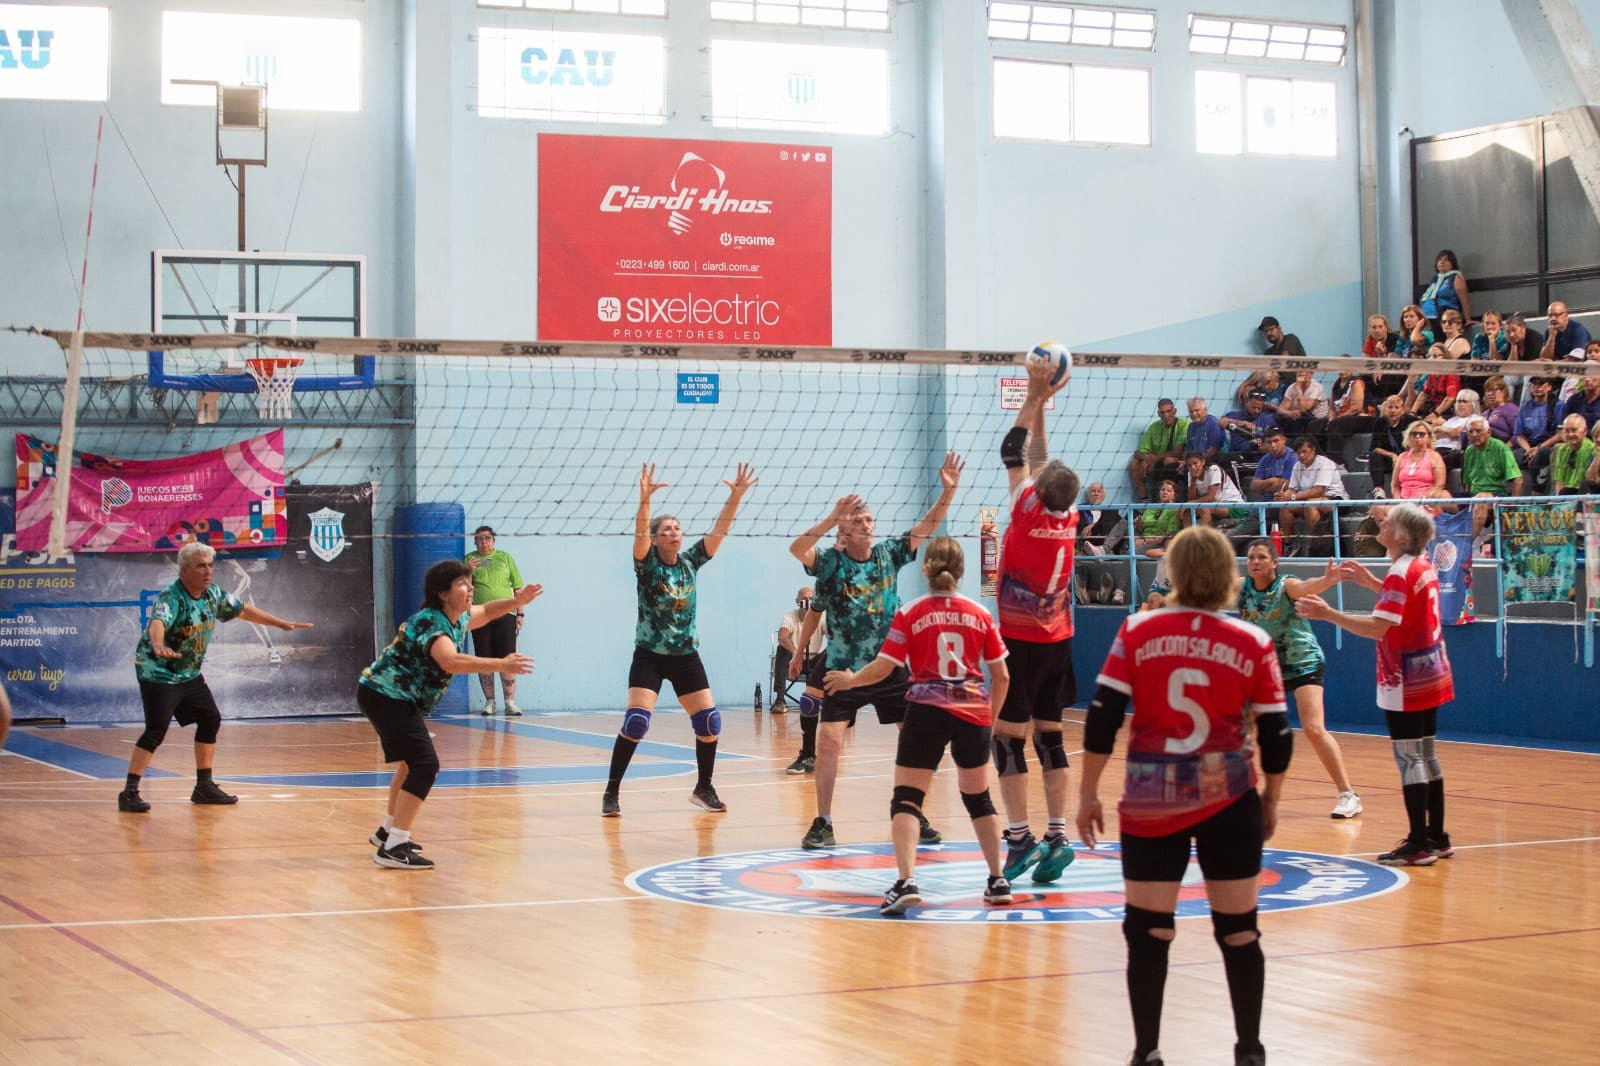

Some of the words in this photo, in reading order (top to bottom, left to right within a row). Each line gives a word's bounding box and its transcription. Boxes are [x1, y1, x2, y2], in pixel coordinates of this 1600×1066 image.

[520, 47, 616, 87] CAU
[600, 185, 698, 213] Ciardi
[699, 189, 773, 214] Hnos.
[668, 260, 690, 270] 1600
[702, 261, 760, 272] ciardi.com.ar
[613, 329, 725, 340] PROYECTORES
[734, 331, 761, 340] LED
[138, 493, 204, 502] BONAERENSES
[1046, 546, 1065, 594] 1
[18, 578, 34, 589] DE
[36, 578, 76, 589] PAGOS
[0, 626, 78, 636] ENTRENAMIENTO.
[0, 638, 43, 647] PARTIDO.
[937, 631, 967, 681] 8
[7, 668, 36, 682] cerca
[39, 663, 65, 691] tuyo
[1164, 666, 1211, 754] 5
